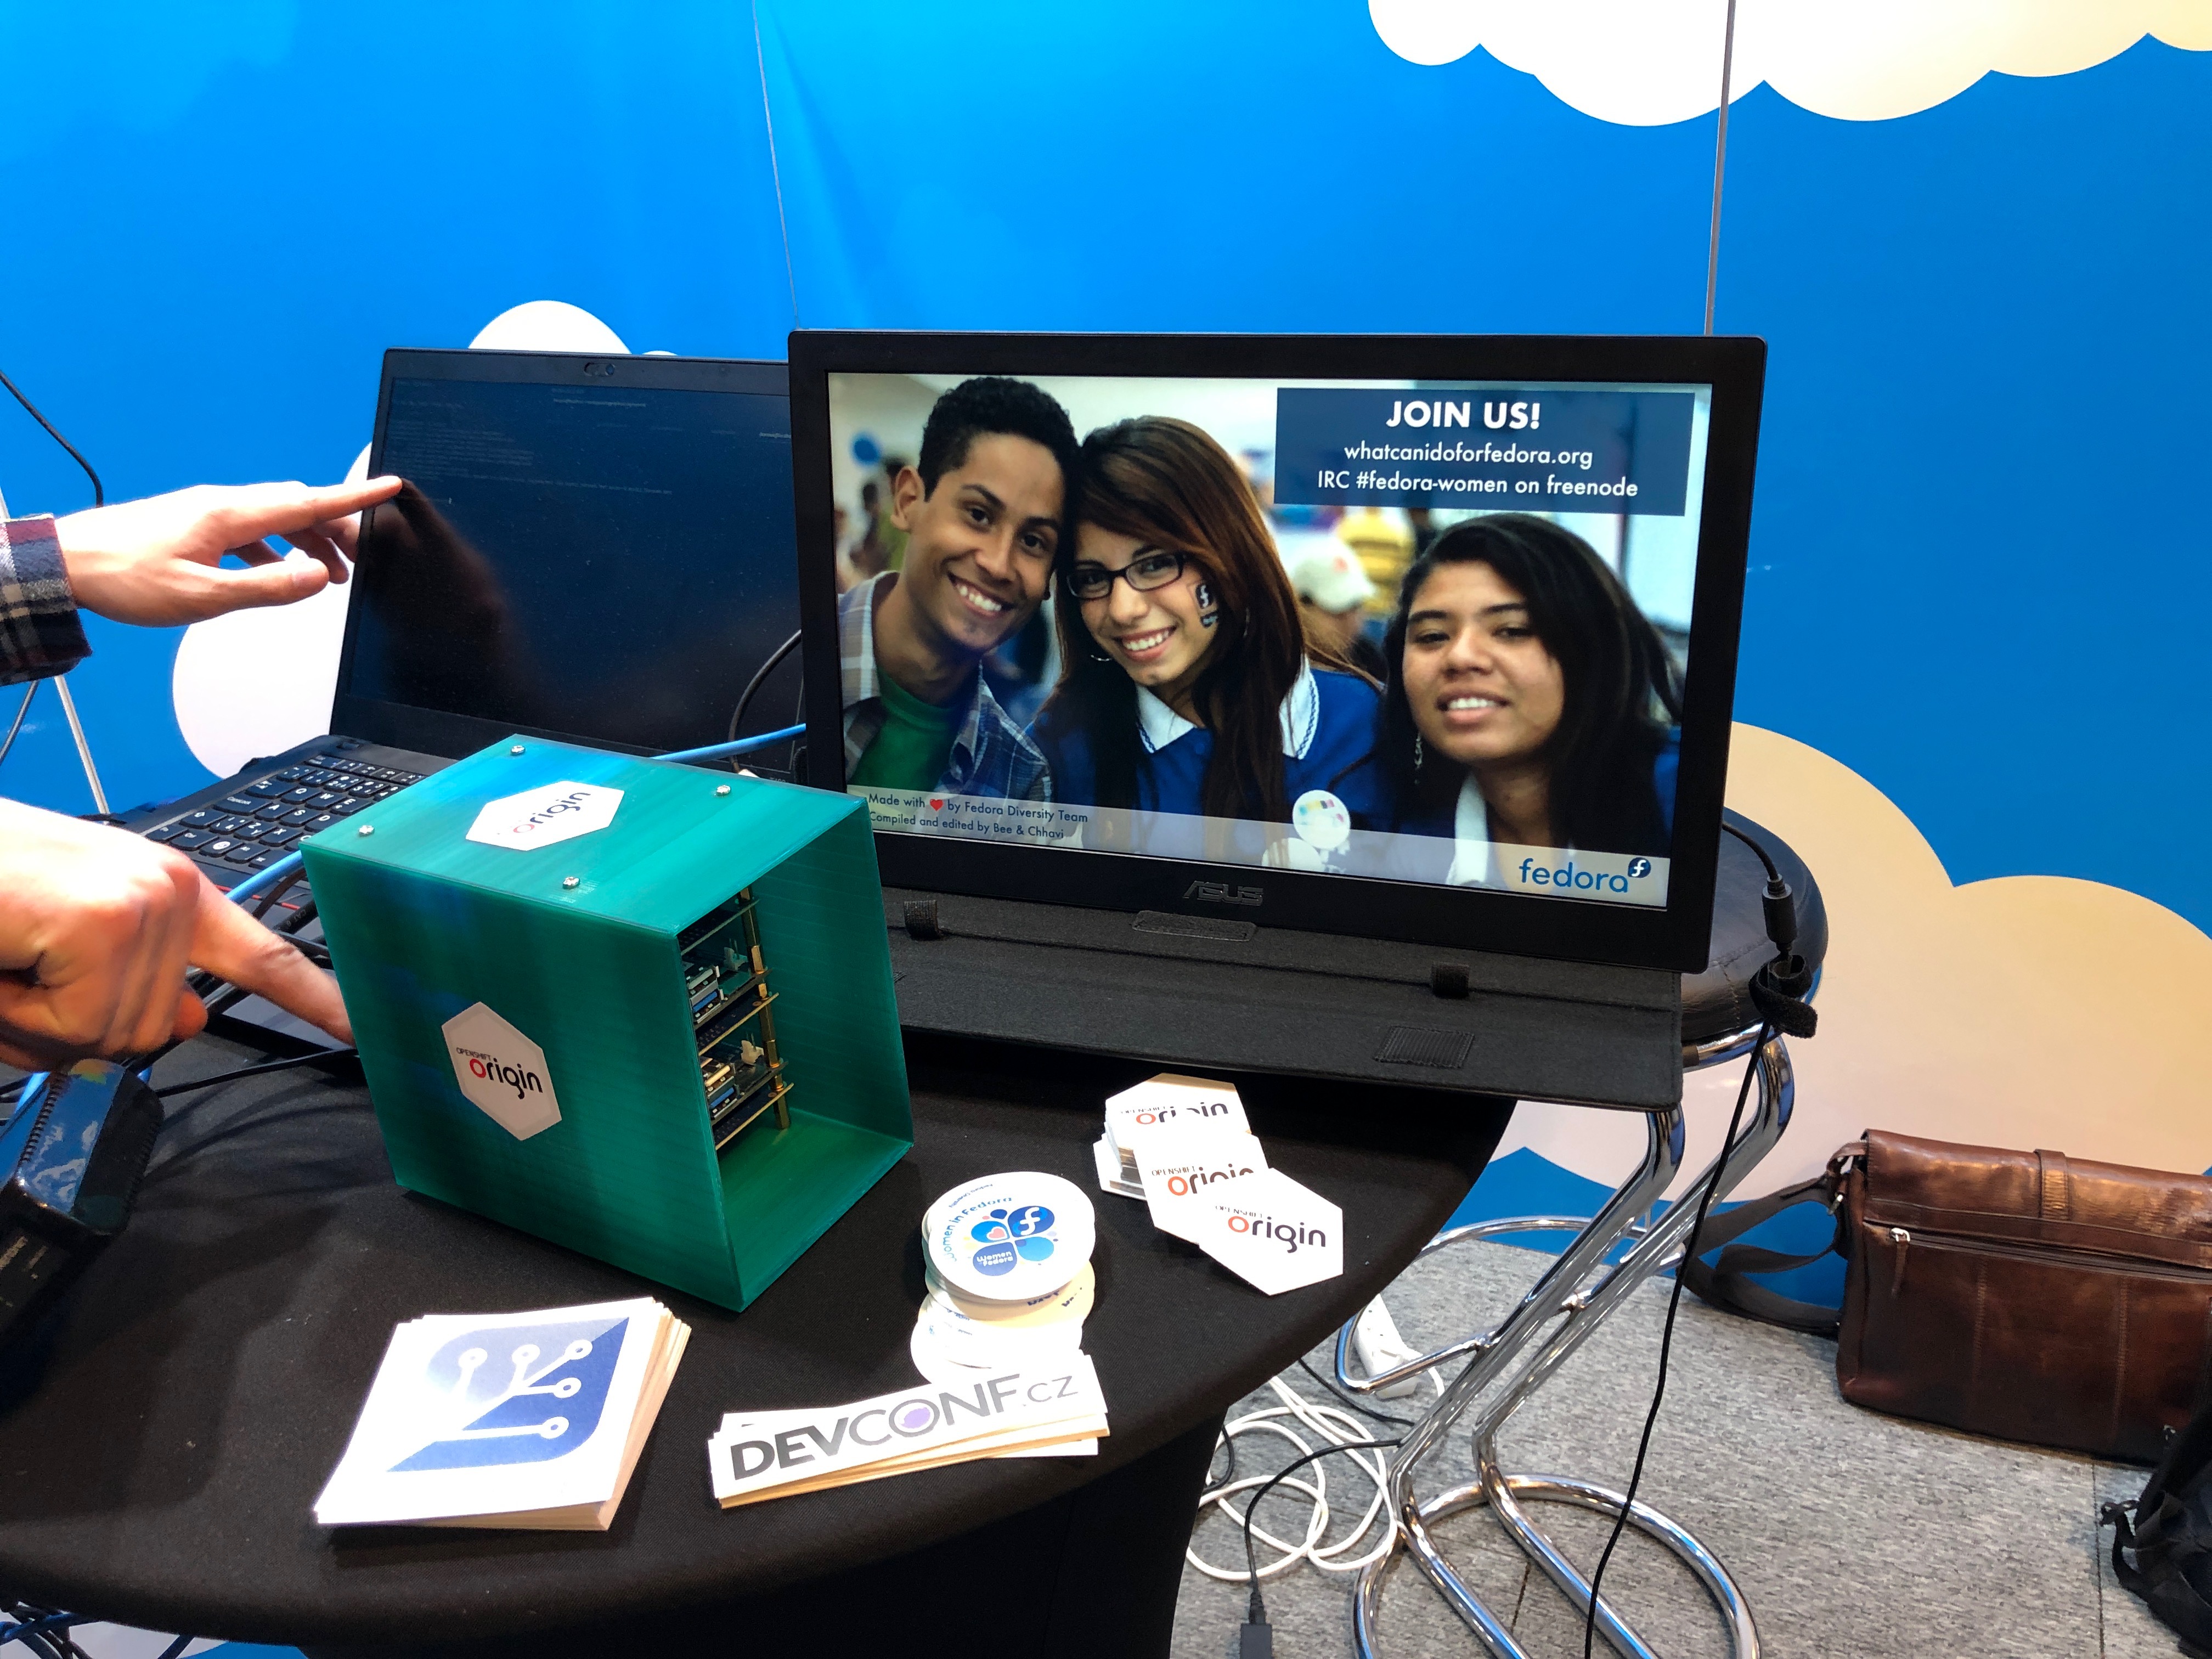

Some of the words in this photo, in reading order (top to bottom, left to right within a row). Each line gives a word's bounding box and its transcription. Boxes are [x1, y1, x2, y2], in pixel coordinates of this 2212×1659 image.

[1386, 400, 1470, 427] JOIN
[1484, 402, 1540, 430] US!
[1344, 440, 1593, 470] whatcanidoforfedora.org
[1318, 470, 1350, 489] IRC
[1356, 470, 1507, 493] #fedora-women
[1515, 481, 1539, 493] on
[1547, 474, 1638, 496] freenode
[513, 792, 591, 833] origin
[869, 793, 899, 805] Made
[904, 797, 926, 808] with
[948, 799, 960, 814] by
[966, 802, 1003, 815] Fedora
[1008, 805, 1054, 822] Diversity
[1058, 810, 1087, 822] Team
[870, 811, 916, 825] Compiled
[919, 817, 939, 827] and
[943, 819, 973, 830] edited
[978, 821, 989, 834] by
[994, 823, 1012, 834] Bee
[1016, 825, 1024, 835] &
[1028, 826, 1063, 838] Chhavi
[1519, 857, 1628, 893] fedora
[1182, 880, 1264, 906] ASUS
[456, 1047, 492, 1061] OPENSHIFT
[469, 1057, 543, 1100] origin
[1227, 1215, 1326, 1254] origin
